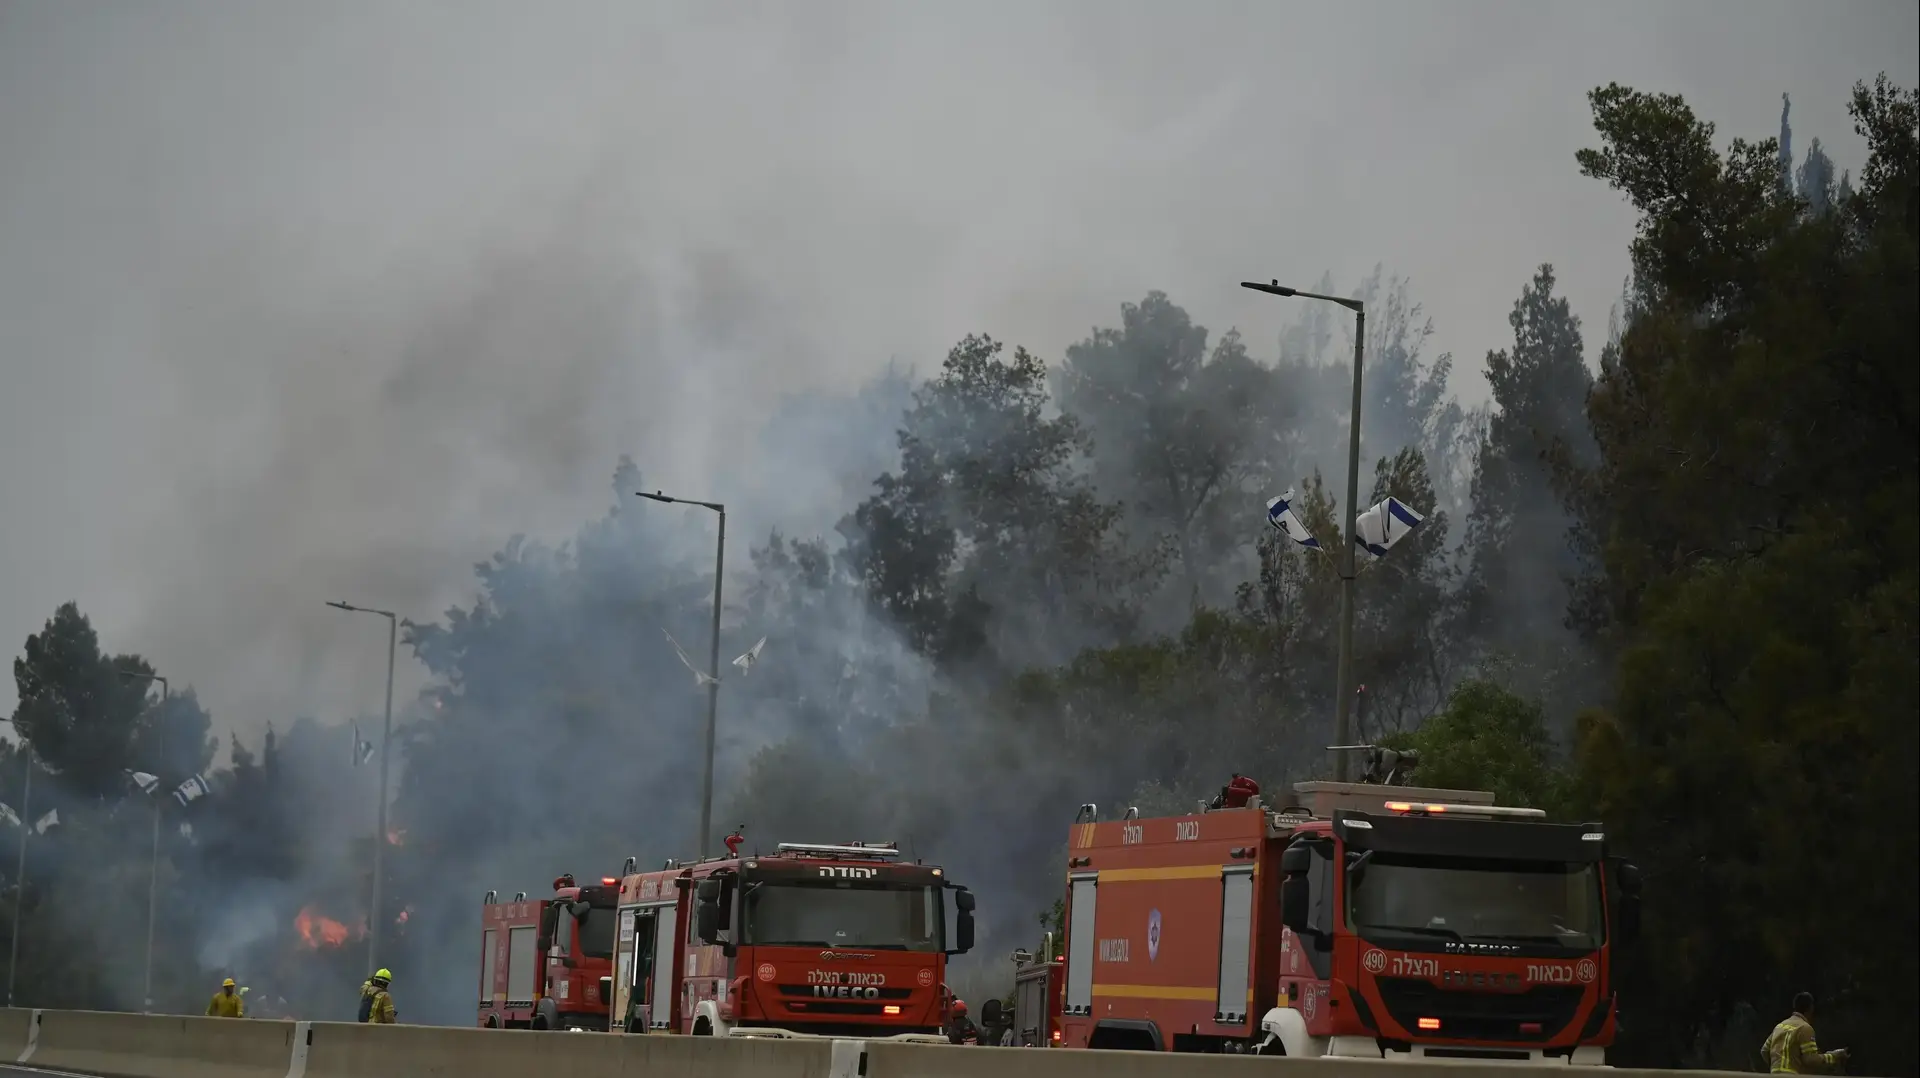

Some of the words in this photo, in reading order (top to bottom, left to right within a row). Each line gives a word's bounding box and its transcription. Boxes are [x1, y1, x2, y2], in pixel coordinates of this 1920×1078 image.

[1123, 820, 1143, 844] והצלה
[1176, 821, 1199, 841] כבאות
[819, 866, 877, 878] יהודה
[1365, 953, 1384, 969] 490
[1393, 953, 1438, 976] והצלה
[760, 966, 773, 974] 401
[848, 971, 886, 985] כבאות
[919, 971, 932, 979] 401
[1527, 964, 1573, 982] כבאות
[1578, 962, 1594, 979] 490
[1444, 969, 1520, 988] IVECO
[813, 985, 879, 1000] IVECO
